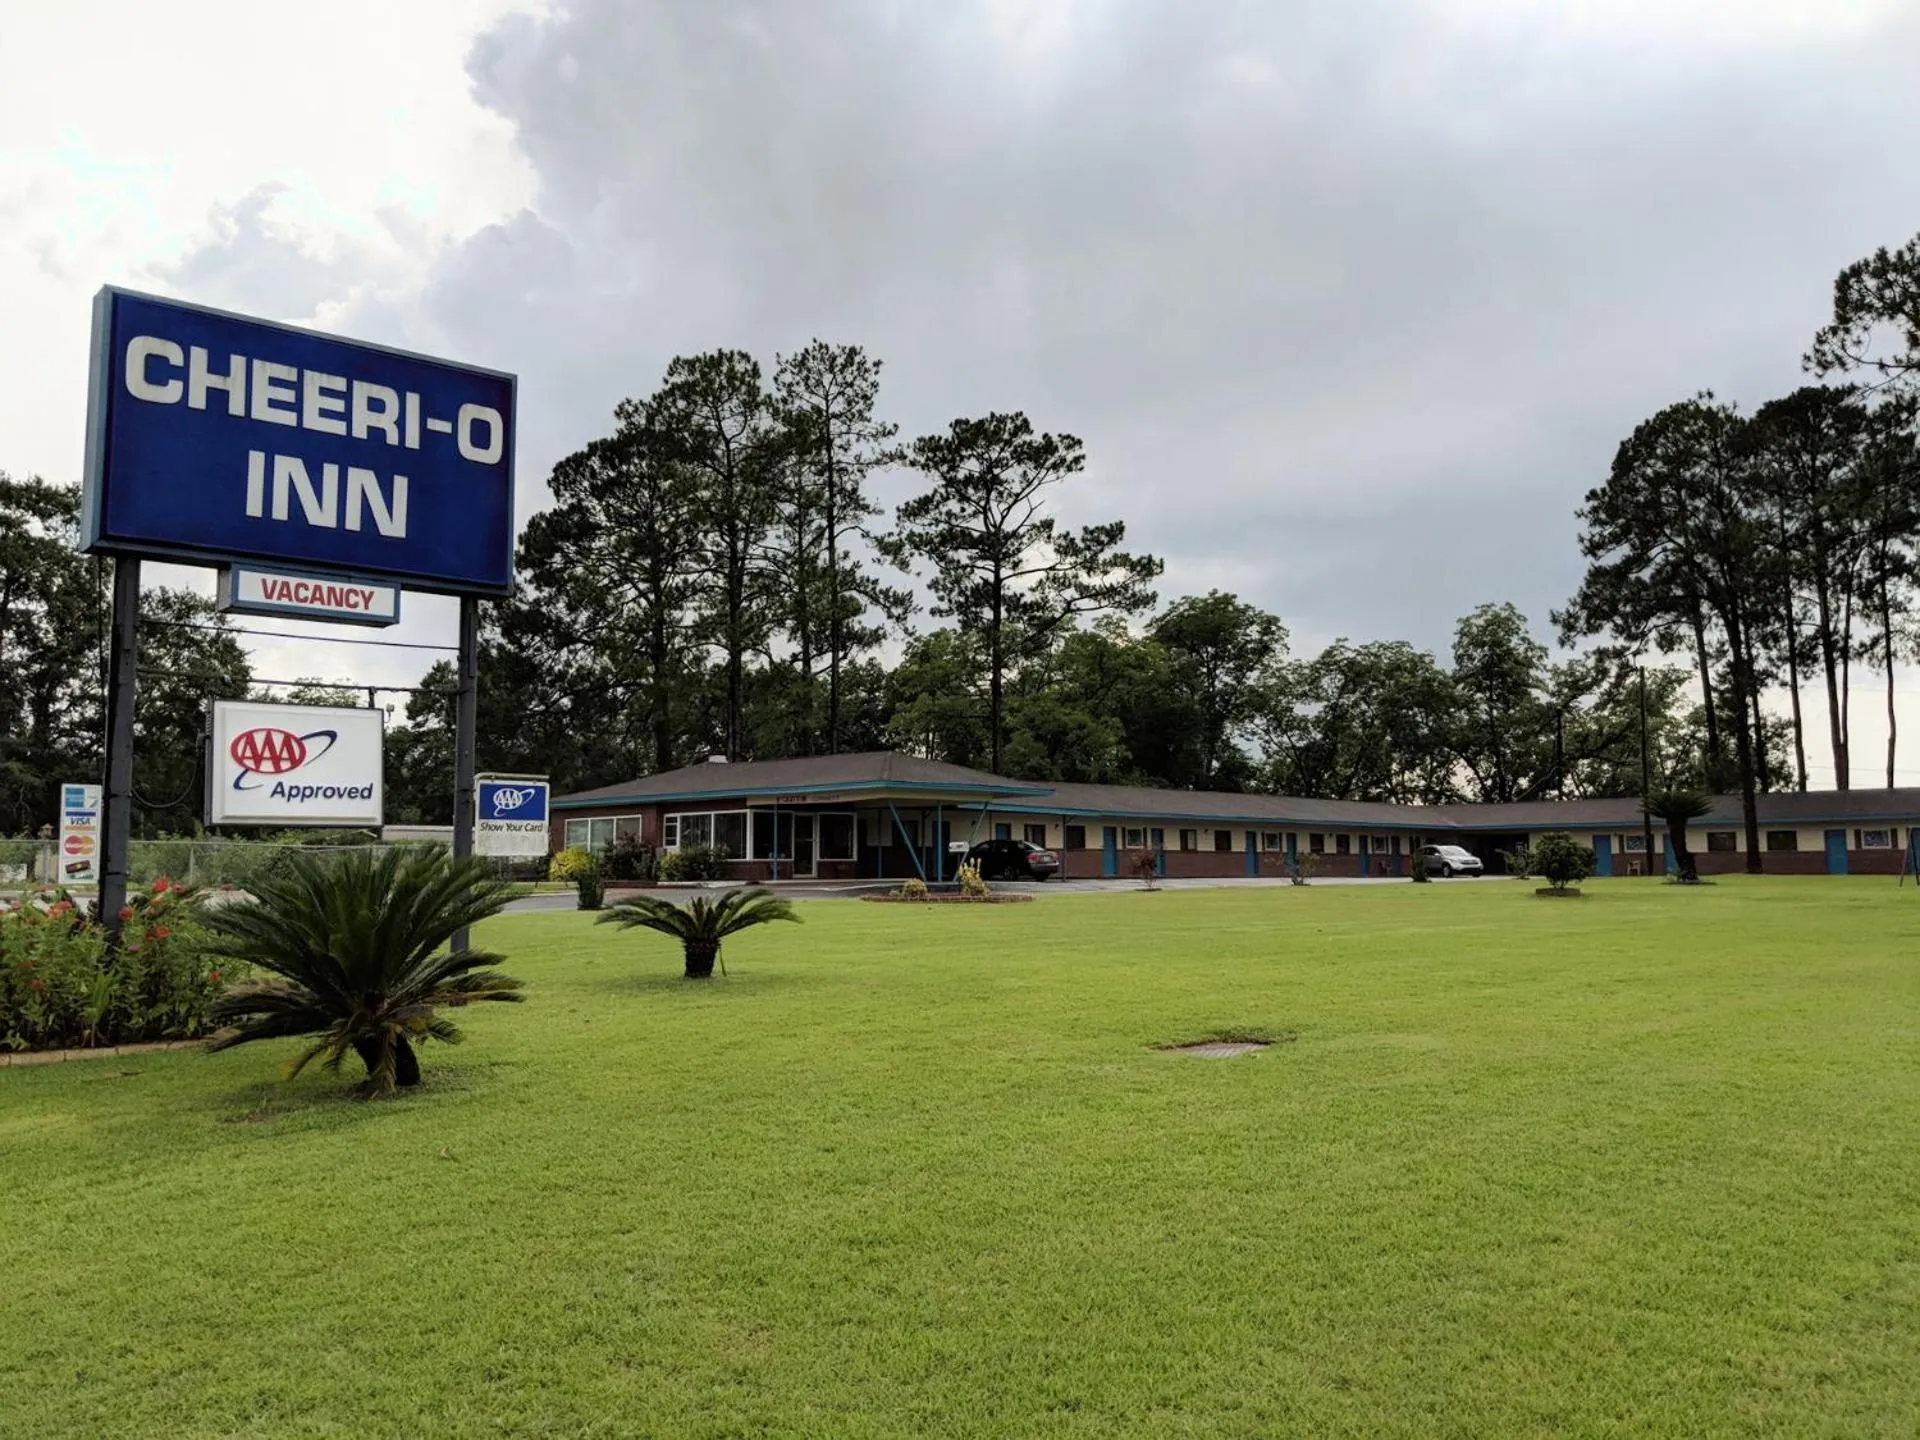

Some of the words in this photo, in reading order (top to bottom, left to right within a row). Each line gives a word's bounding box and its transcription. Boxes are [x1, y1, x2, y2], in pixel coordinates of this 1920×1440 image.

[125, 335, 503, 464] CHEERI-O
[246, 450, 408, 538] INN
[261, 578, 375, 610] VACANCY
[240, 729, 301, 772] AAA
[270, 781, 373, 803] Approved
[70, 817, 91, 826] VISA
[480, 822, 504, 832] Show
[506, 822, 522, 832] Your
[524, 822, 543, 832] Card
